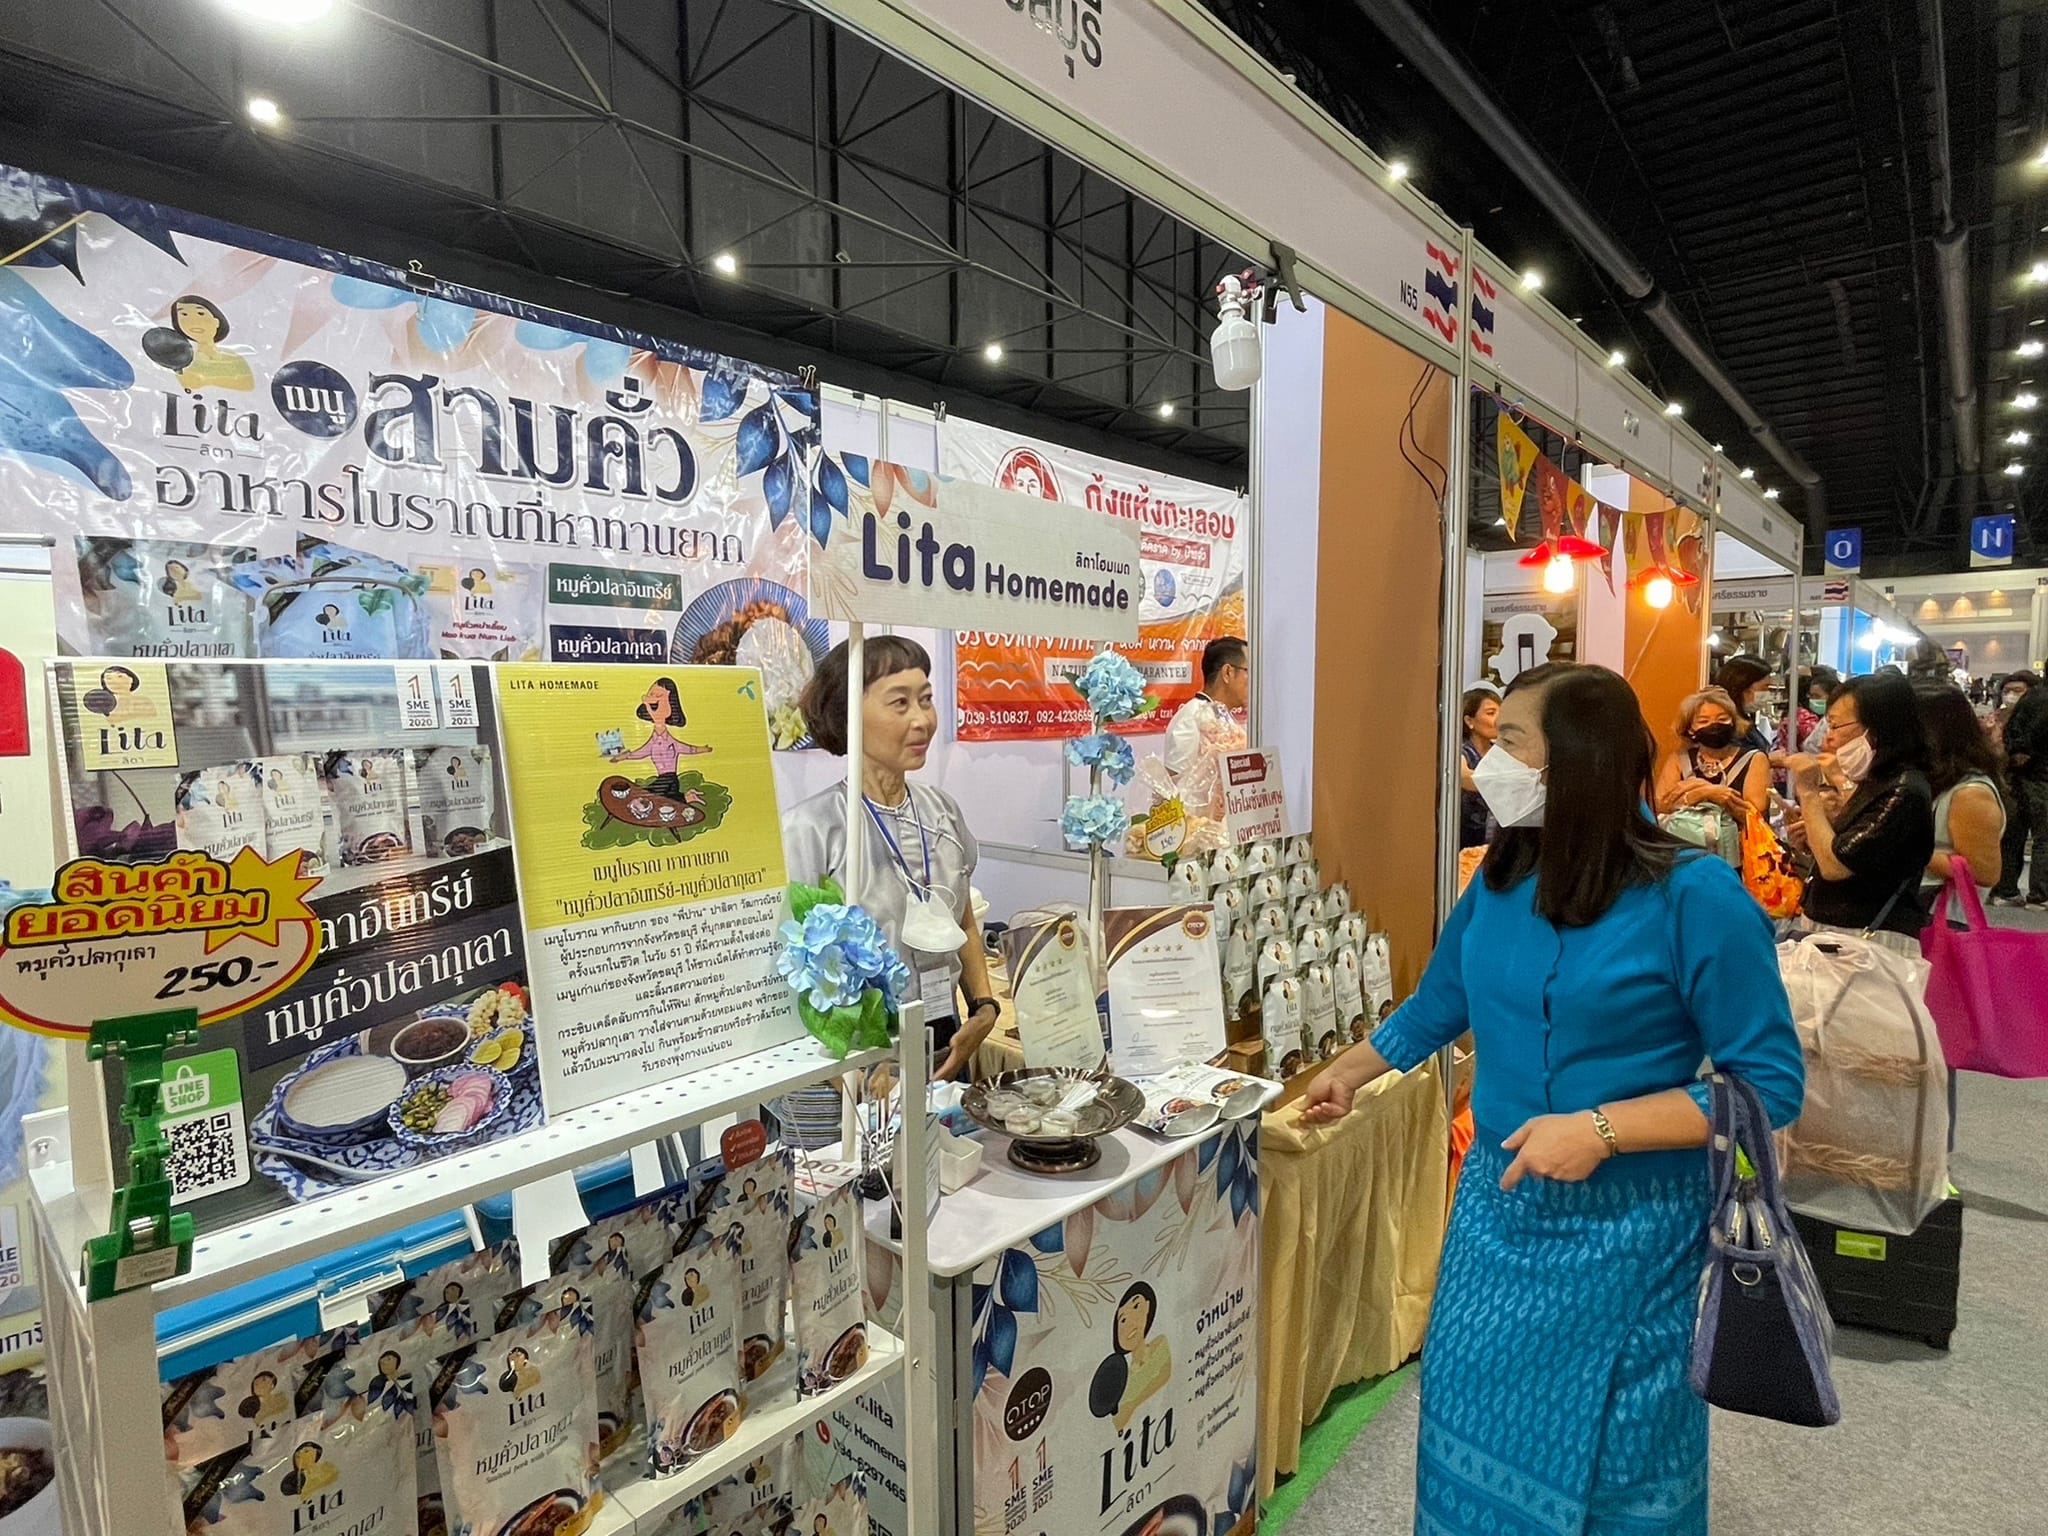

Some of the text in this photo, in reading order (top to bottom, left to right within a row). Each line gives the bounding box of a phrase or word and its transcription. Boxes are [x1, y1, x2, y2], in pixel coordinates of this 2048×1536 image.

[1401, 280, 1418, 311] N55
[162, 390, 264, 441] Lita
[283, 385, 346, 425] เมนู
[364, 371, 696, 502] สามคั่ว
[200, 443, 234, 459] ลิตา
[156, 464, 745, 564] อาหารโบราณที่หาทานยาก
[1085, 473, 1235, 539] ก้งแห้งทะเลอบ
[1981, 527, 2002, 549] N
[863, 511, 1130, 611] Lita Homemade
[1075, 552, 1130, 575] ลิตาโฮมเมด
[556, 573, 671, 600] หมูคั่วปลาอินทรีย์
[1712, 589, 1768, 600] ศรีธรรมราช
[168, 603, 208, 626] Lita
[465, 594, 495, 611] Lita
[323, 628, 352, 643] Lita
[558, 635, 662, 658] หมูคั่วปลากุเลา
[510, 679, 600, 691] LITA HOMEMADE
[406, 701, 430, 710] SME
[449, 700, 471, 709] SME
[409, 718, 432, 727] 2020
[452, 717, 473, 726] 2021
[101, 724, 166, 755] Lita
[66, 858, 221, 897] สินค้า
[593, 857, 661, 884] เมนูโบราณ
[17, 894, 259, 938] ยอดนิยม
[319, 868, 473, 955] ลาอินทรีย์
[543, 929, 598, 948] เมนูโบราณ
[601, 919, 647, 936] หากินยาก
[670, 948, 681, 958] 51
[265, 927, 513, 1046] หมูคั่วปลากุเลา
[562, 1030, 635, 1059] หมูคั่วปลากุเลา
[168, 1080, 204, 1097] LINE
[170, 1091, 205, 1108] SHOP
[741, 1258, 755, 1273] ta
[690, 1306, 714, 1335] Lita
[1196, 1286, 1244, 1335] จำหน่าย
[508, 1391, 546, 1426] Lita
[1006, 1384, 1050, 1425] OTOP
[854, 1422, 907, 1473] Homema
[1099, 1407, 1177, 1517] Lita
[1033, 1465, 1054, 1491] SME
[293, 1489, 345, 1534] Lita
[1005, 1485, 1027, 1513] SME
